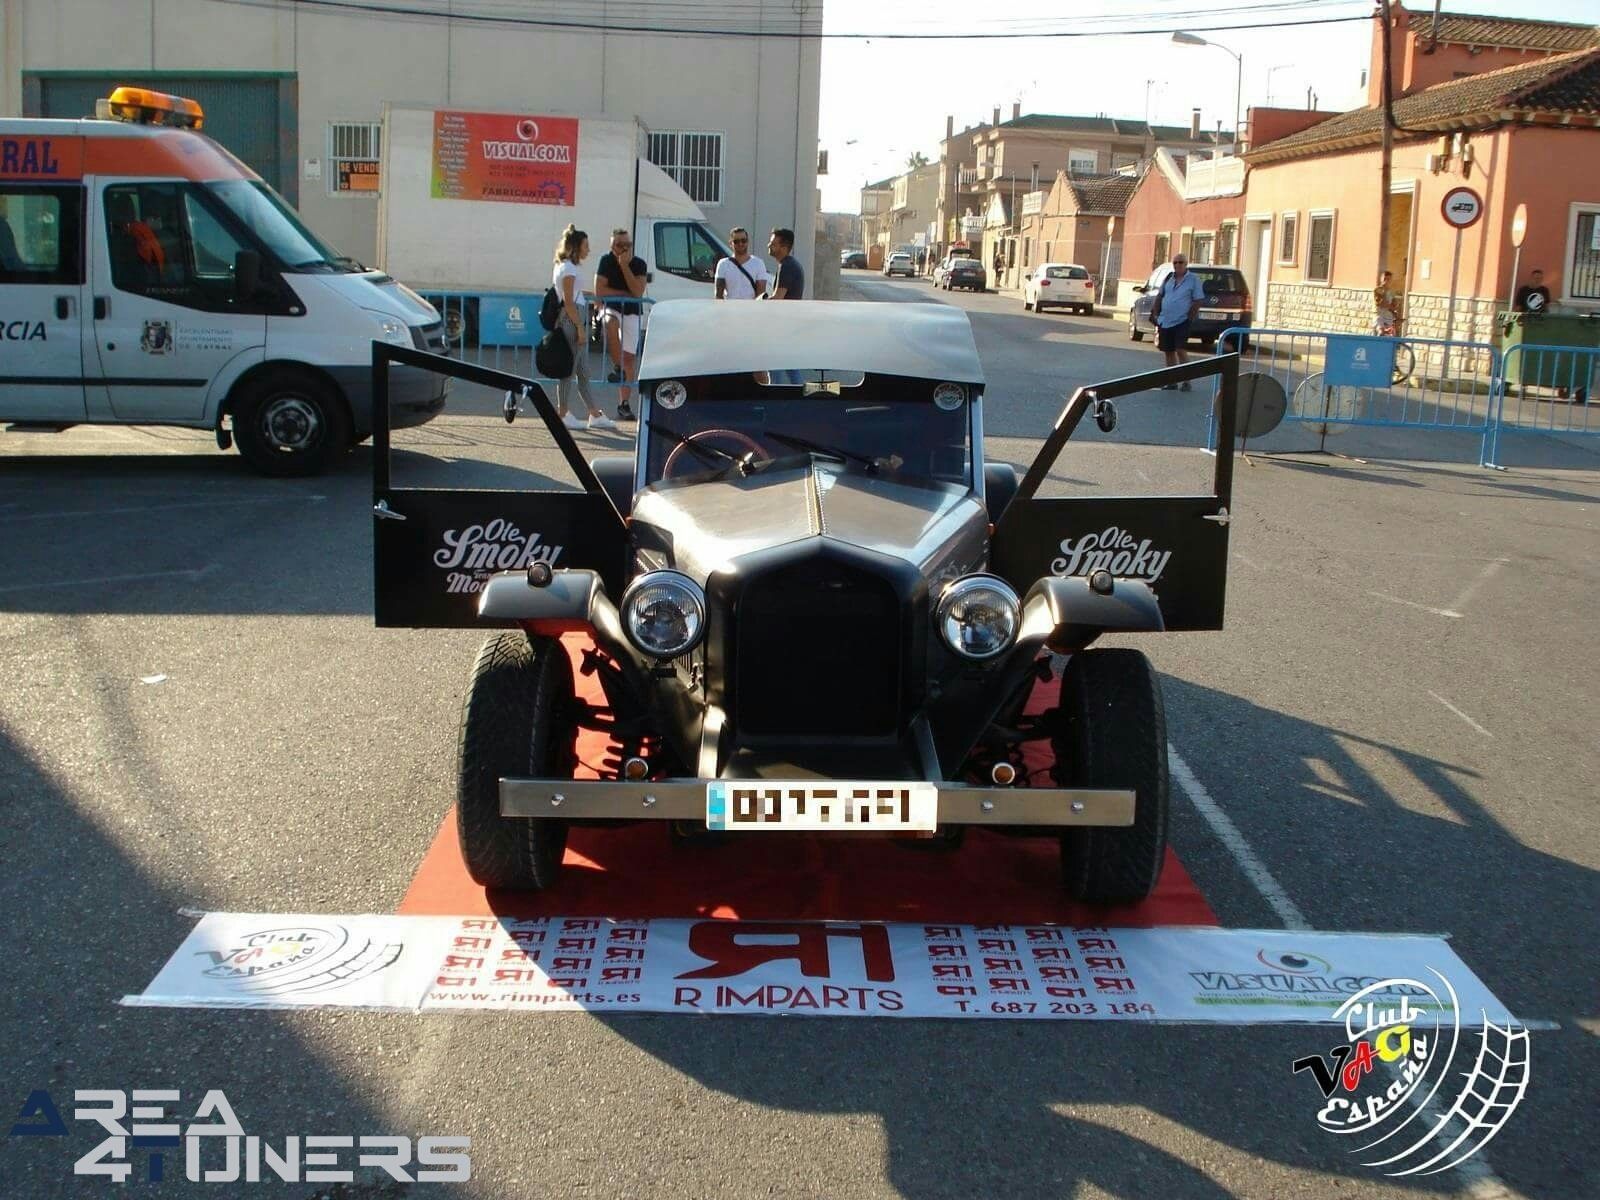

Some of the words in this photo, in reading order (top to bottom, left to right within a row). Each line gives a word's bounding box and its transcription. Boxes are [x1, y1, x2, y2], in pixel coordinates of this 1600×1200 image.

[2, 140, 58, 173] RAL
[482, 140, 571, 163] VISUALCOM
[482, 186, 557, 199] FABRICANTES
[484, 518, 527, 544] Ole
[1099, 526, 1138, 550] Ole
[433, 525, 563, 569] Smoky
[1051, 533, 1172, 583] Smoky
[428, 991, 641, 1005] www.rimparts.es
[954, 1000, 980, 1014] T.
[991, 1002, 1038, 1015] 687
[1050, 1002, 1098, 1015] 203
[1109, 1003, 1155, 1016] 184
